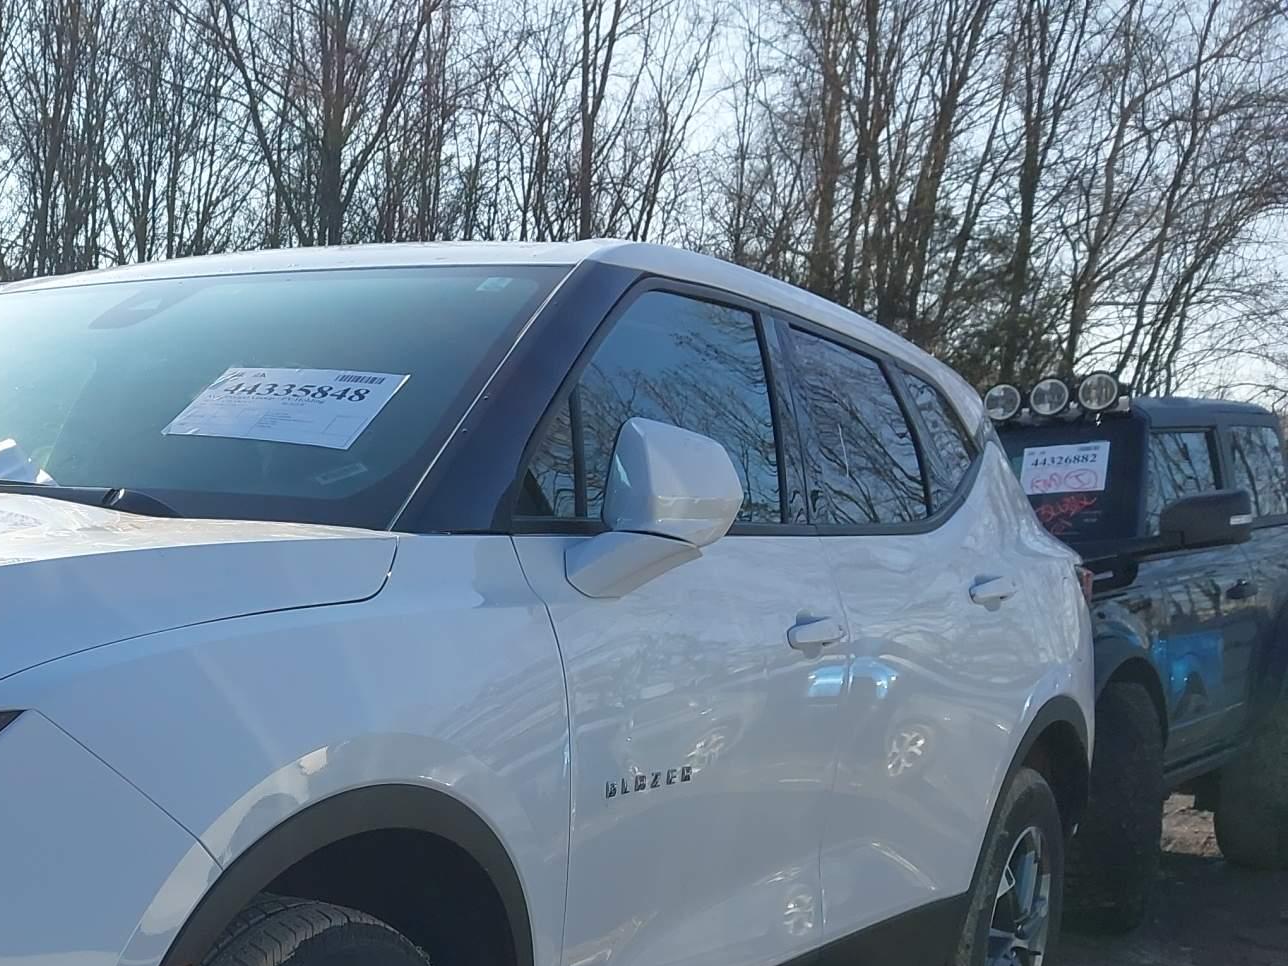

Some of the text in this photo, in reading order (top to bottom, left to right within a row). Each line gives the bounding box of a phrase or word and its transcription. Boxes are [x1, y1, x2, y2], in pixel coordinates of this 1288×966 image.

[224, 382, 371, 403] 44335848
[1030, 453, 1097, 466] 44326882
[605, 766, 693, 799] BLAZER
